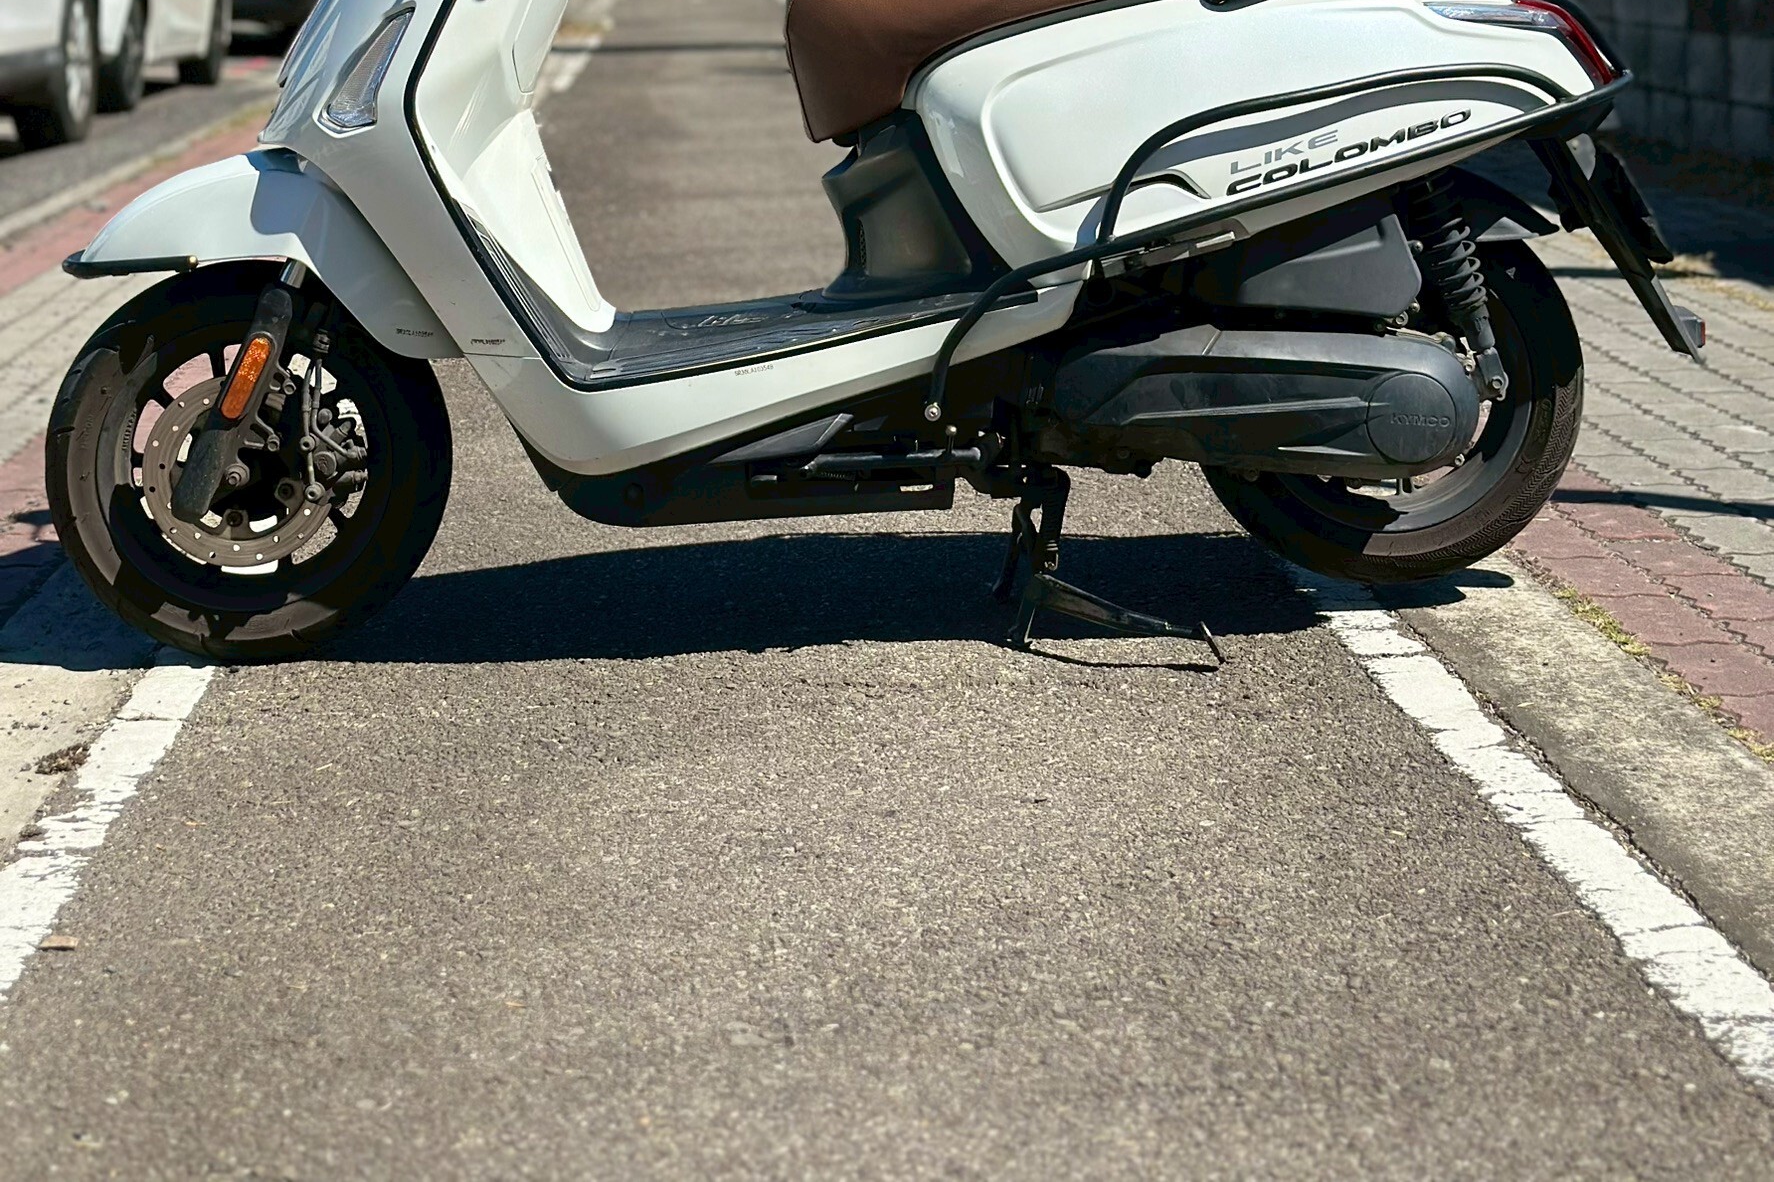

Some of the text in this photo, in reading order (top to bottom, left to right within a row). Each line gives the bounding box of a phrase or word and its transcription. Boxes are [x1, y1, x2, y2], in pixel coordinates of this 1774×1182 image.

[1226, 108, 1472, 196] COLOMBO
[1230, 129, 1338, 175] LIKE
[1390, 412, 1451, 428] KYMCO
